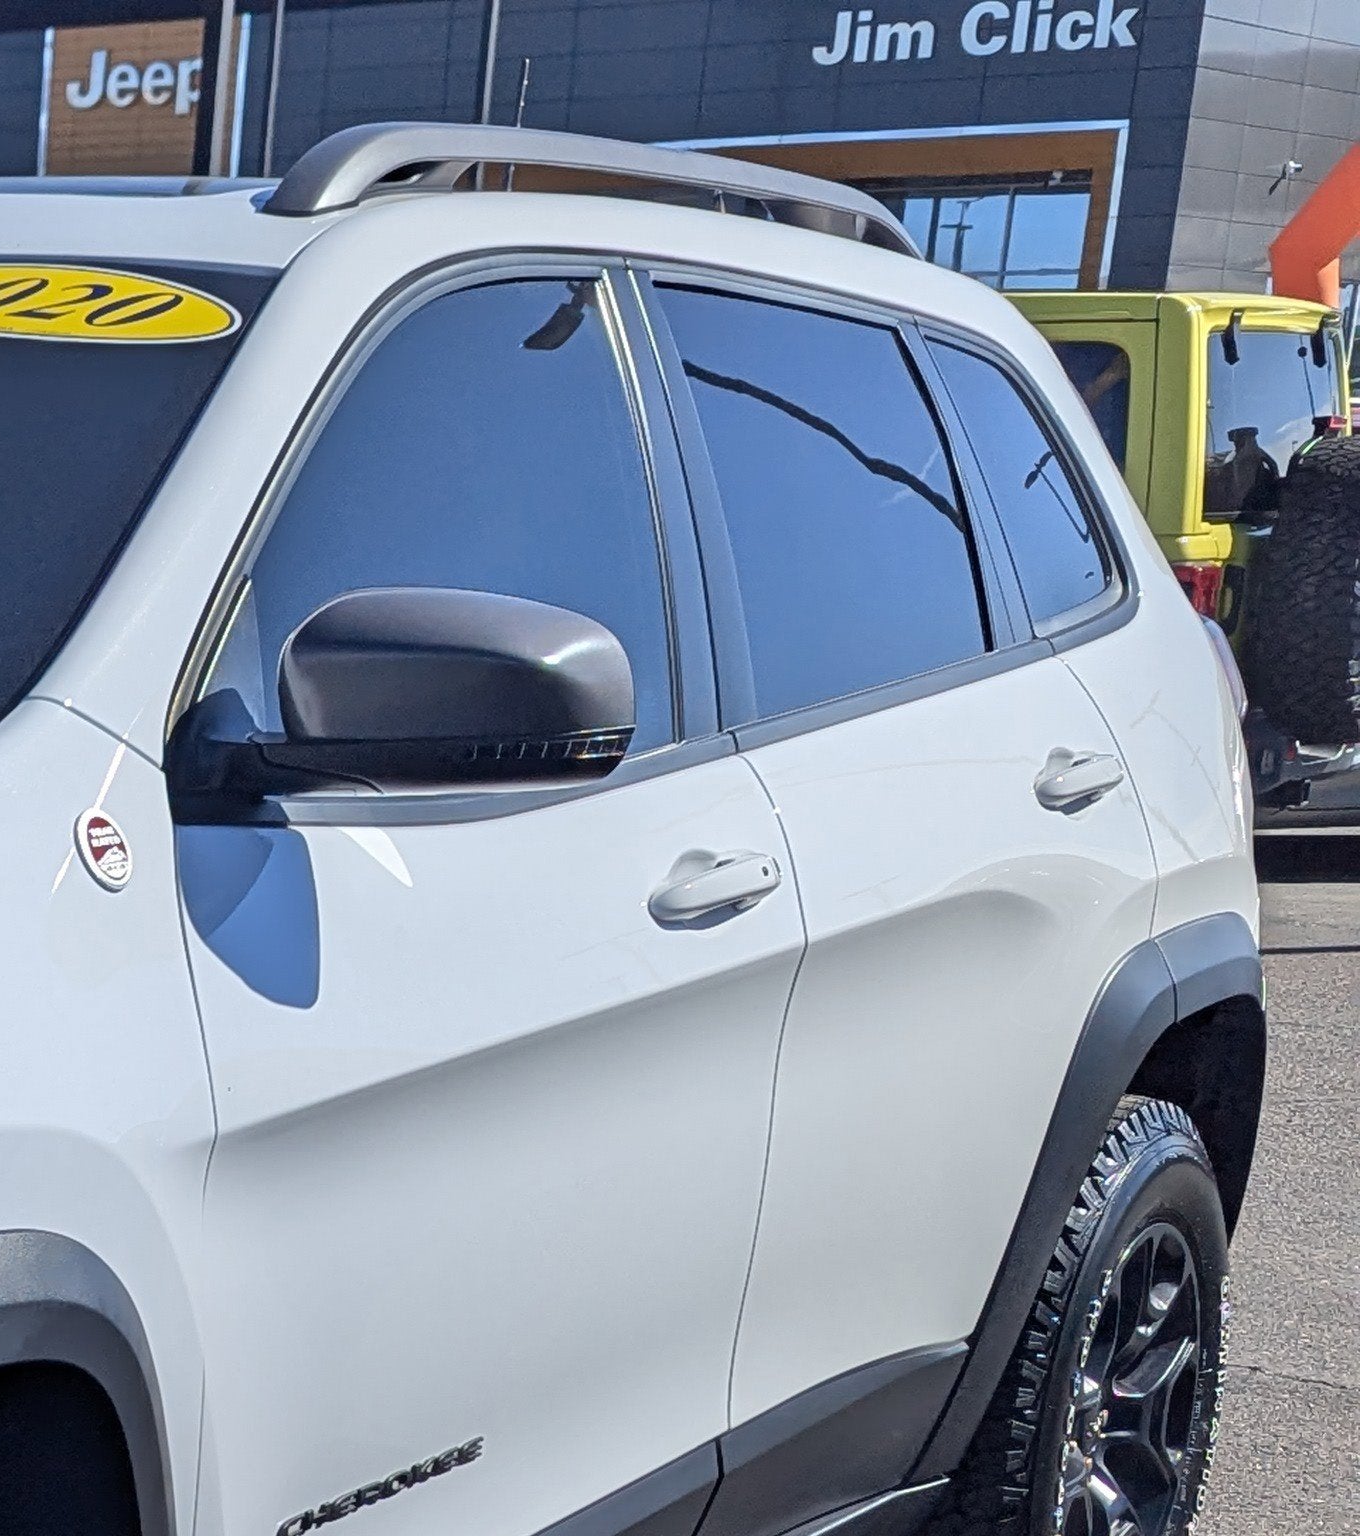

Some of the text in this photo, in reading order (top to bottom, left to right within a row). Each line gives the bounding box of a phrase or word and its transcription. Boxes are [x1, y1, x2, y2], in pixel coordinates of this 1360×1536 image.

[812, 0, 1139, 66] Jim Click
[65, 49, 204, 116] Jeep
